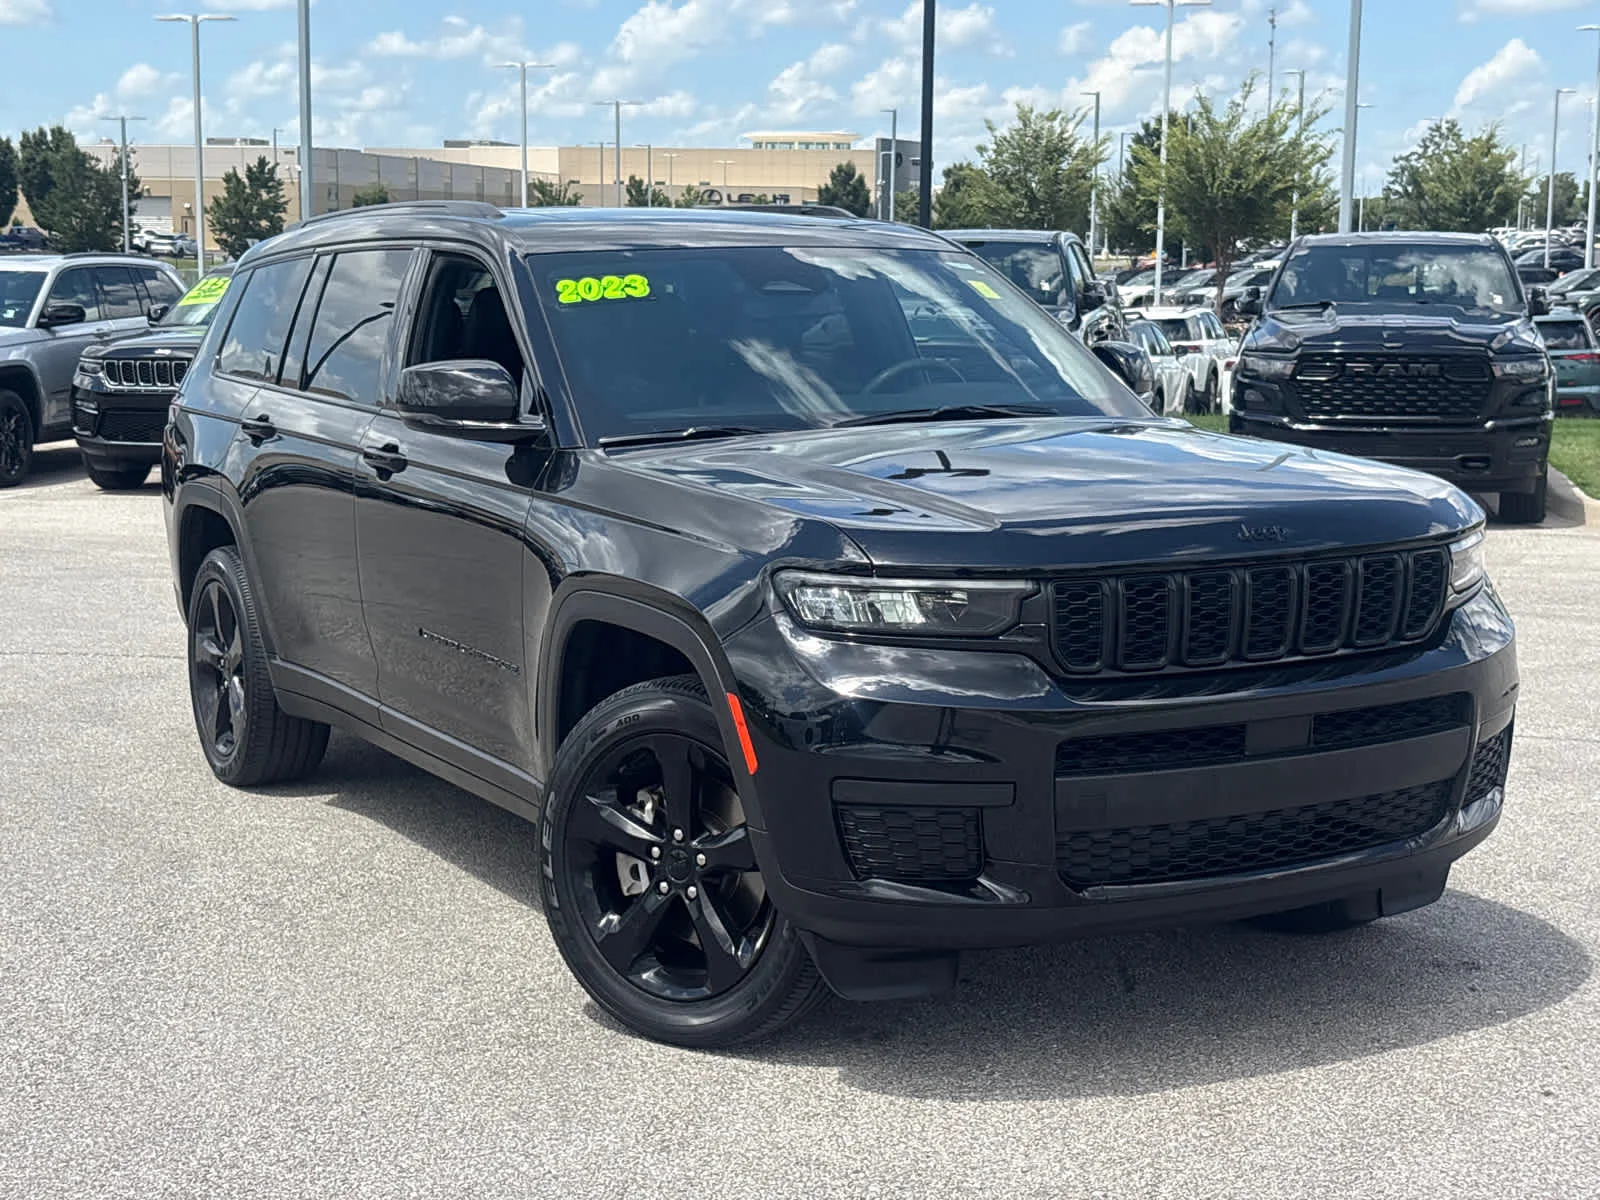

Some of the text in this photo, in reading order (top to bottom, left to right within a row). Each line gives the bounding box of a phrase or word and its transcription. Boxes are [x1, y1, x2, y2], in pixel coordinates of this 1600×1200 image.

[726, 193, 791, 204] LEUS
[556, 274, 650, 303] 2023
[1344, 363, 1441, 376] RAM
[1237, 522, 1289, 542] Jeep
[616, 714, 640, 728] 400
